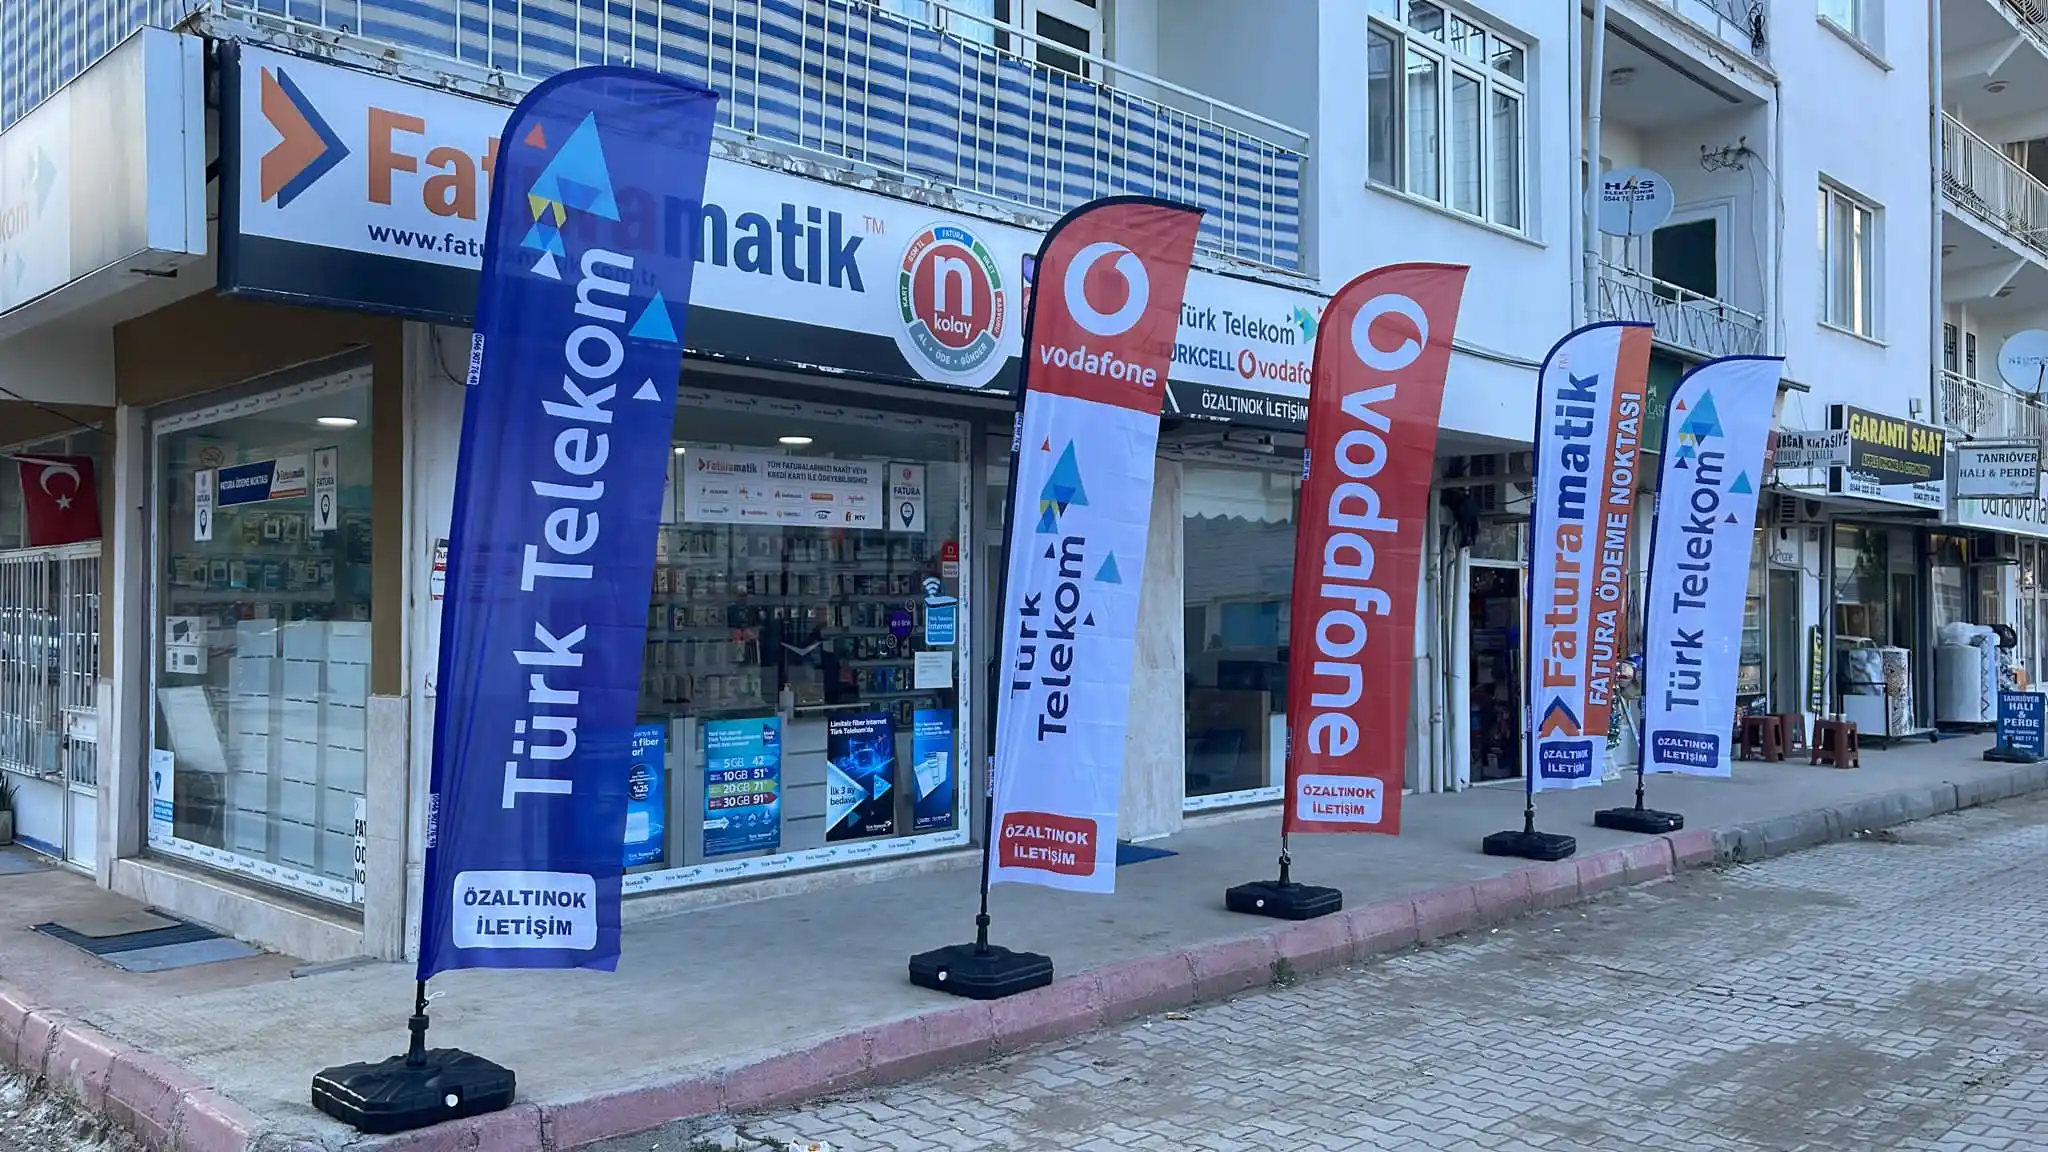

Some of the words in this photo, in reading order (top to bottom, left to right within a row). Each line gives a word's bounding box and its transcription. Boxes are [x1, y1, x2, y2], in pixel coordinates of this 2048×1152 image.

[1604, 180, 1655, 190] HAS
[863, 216, 885, 235] TM
[942, 229, 965, 241] FATURA
[934, 255, 973, 317] n
[934, 313, 972, 339] kolay
[1222, 310, 1295, 346] Telekom
[918, 333, 927, 346] AL
[960, 342, 989, 365] GÖNDER
[1040, 344, 1157, 389] vodafone
[1259, 359, 1312, 385] vodafo
[1202, 388, 1266, 416] ÖZALTINOK
[521, 248, 635, 592] Telekom
[1850, 413, 1908, 450] GARANTİ
[1911, 428, 1942, 457] SAAT
[1608, 392, 1641, 511] NOKTASI
[1976, 451, 2037, 463] TANRIÖVER
[706, 459, 757, 474] Faturamatik
[1960, 468, 1985, 478] HALI
[1988, 468, 1996, 478] &
[1999, 467, 2037, 478] PERDE
[893, 486, 921, 497] FATURA
[1543, 371, 1599, 688] Faturamatik
[1672, 451, 1725, 608] Telekom
[1595, 513, 1629, 601] ÖDEME
[1307, 383, 1398, 757] vodafone
[1011, 591, 1042, 699] Türk
[1038, 535, 1086, 742] Telekom
[1587, 609, 1617, 705] FATURA
[1666, 629, 1704, 712] Türk
[502, 622, 587, 808] Türk
[2009, 702, 2034, 711] HALI
[2003, 718, 2040, 728] PERDE
[639, 739, 659, 747] fiber
[1658, 738, 1714, 750] ÖZALTINOK
[724, 758, 731, 768] 5
[731, 757, 745, 768] GB
[752, 755, 765, 765] 42
[1543, 749, 1588, 761] ÖZALTINOK
[1663, 750, 1708, 762] İLETİŞİM
[724, 771, 734, 781] 10
[735, 770, 748, 780] GB
[754, 768, 764, 778] 51
[724, 784, 735, 794] 20
[736, 783, 750, 792] GB
[830, 795, 857, 805] bedava
[1303, 783, 1376, 799] ÖZALTINOK
[724, 797, 736, 807] 30
[736, 795, 750, 806] GB
[753, 794, 764, 804] 91
[1312, 802, 1366, 816] İLETİŞİM
[1005, 824, 1089, 847] ÖZALTINOK
[1013, 844, 1076, 868] İLETİŞİM
[464, 887, 587, 910] ÖZALTINOK
[476, 916, 573, 940] İLETİŞİM
